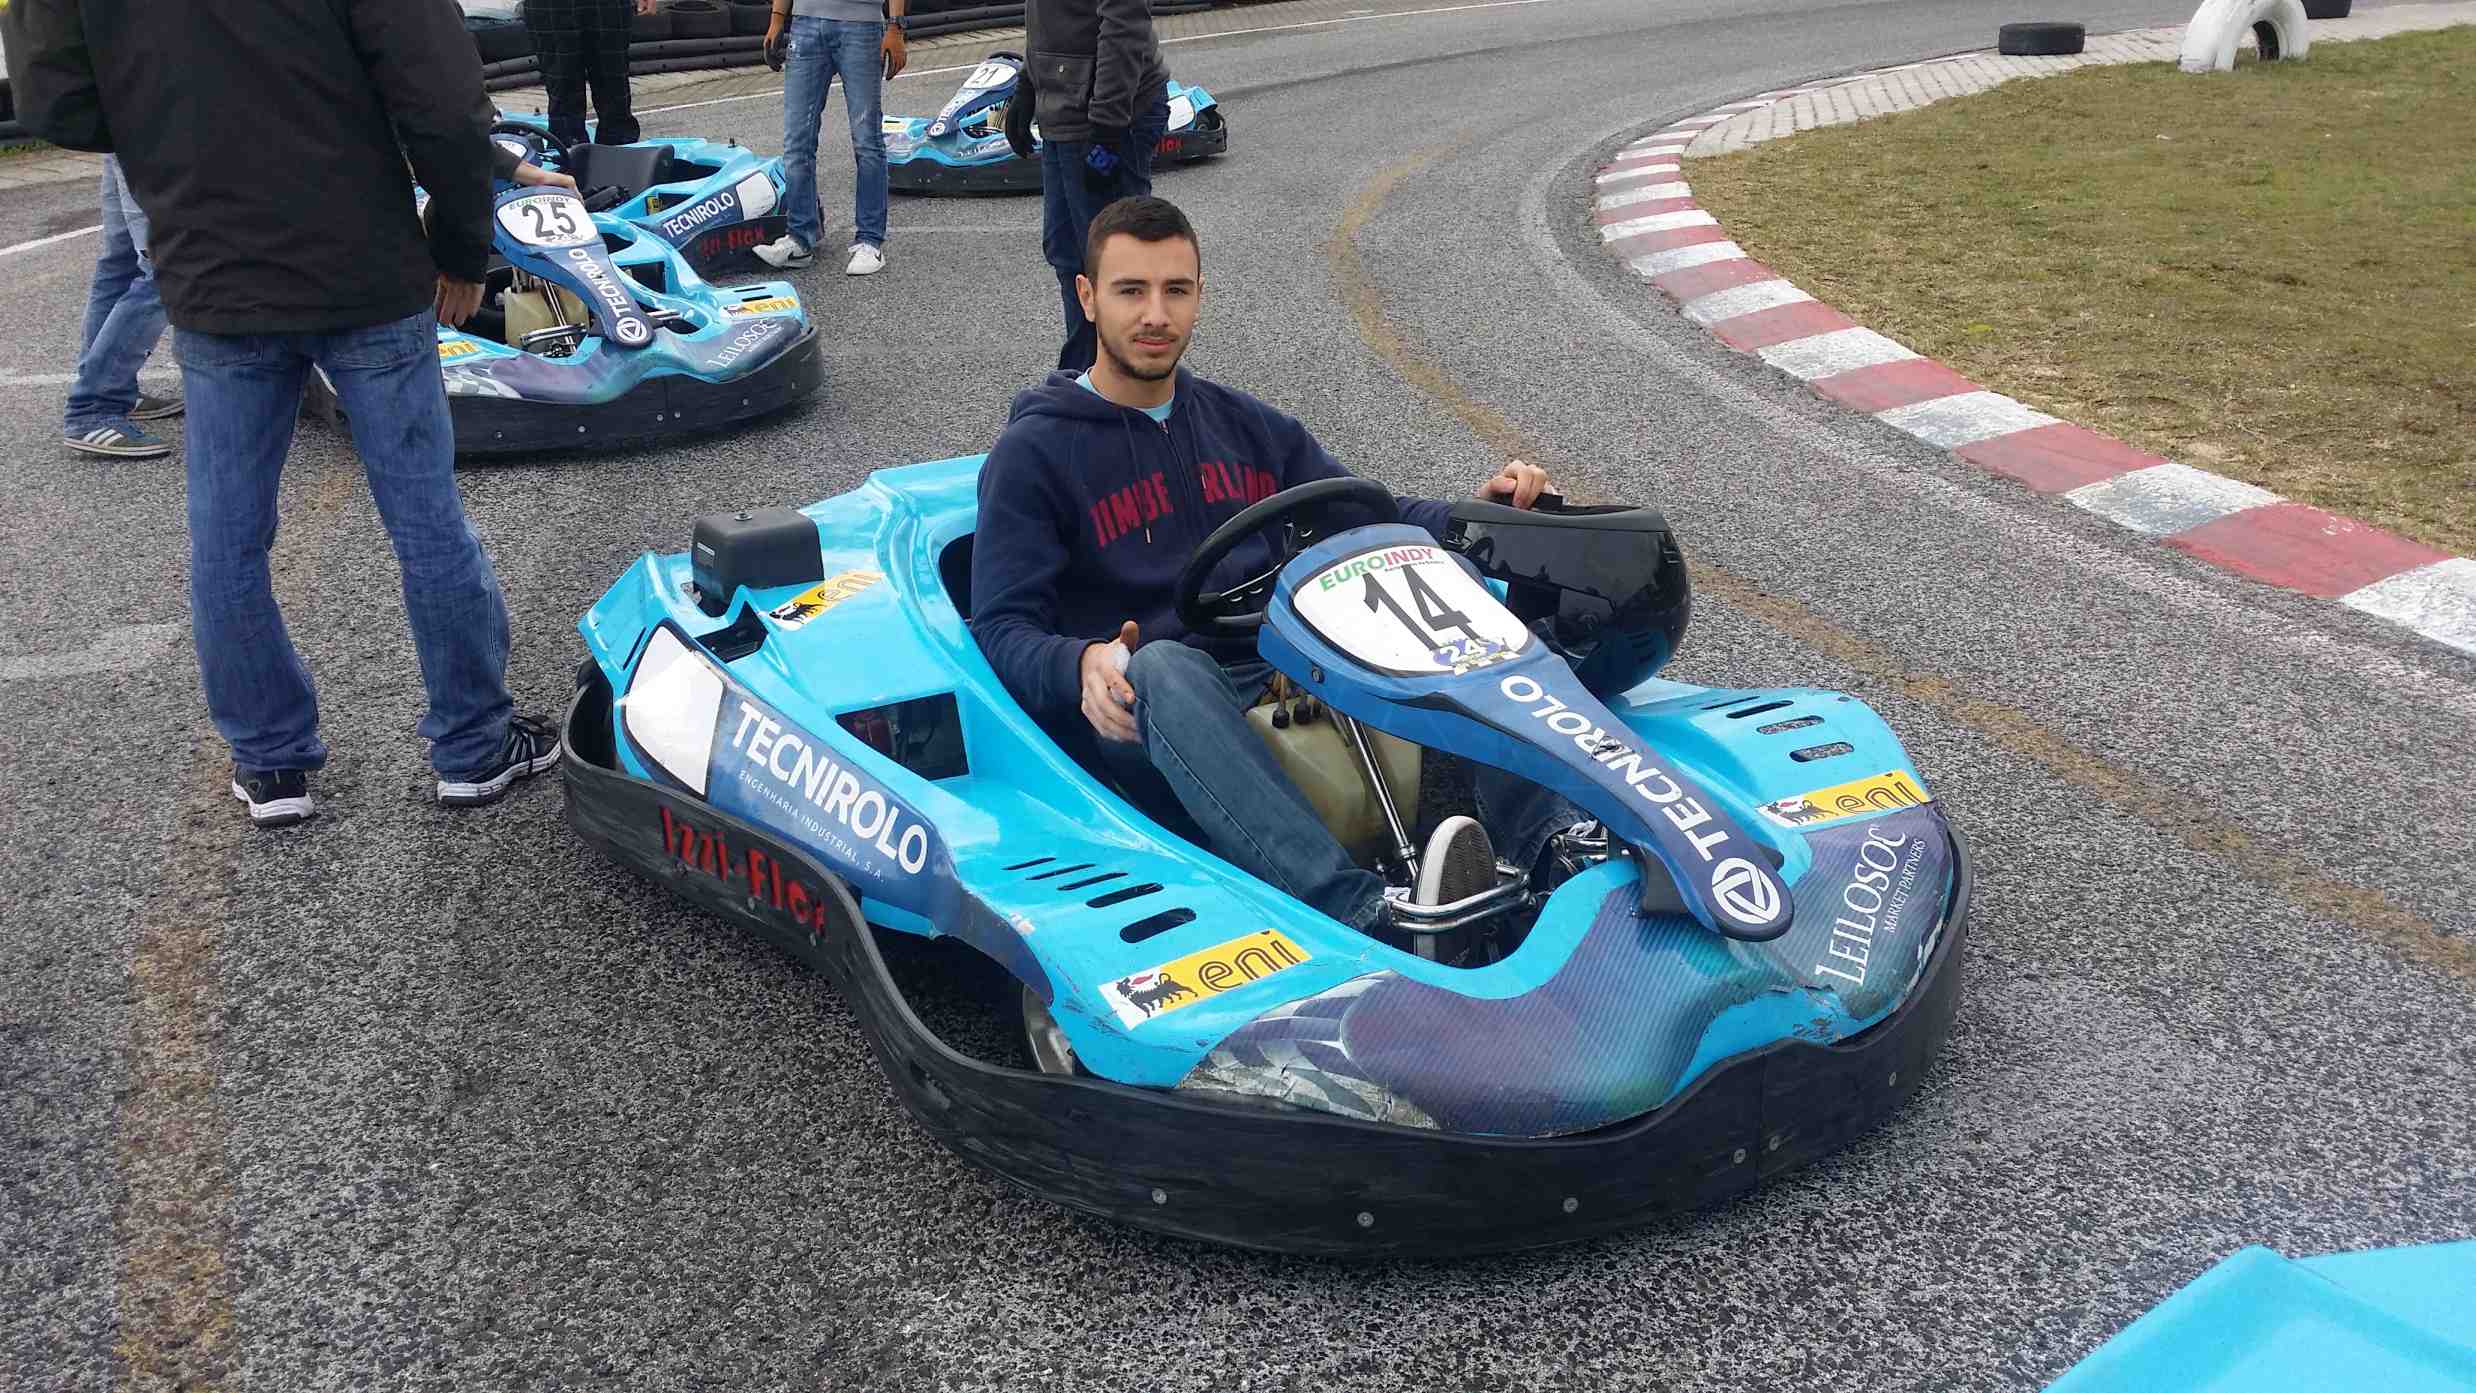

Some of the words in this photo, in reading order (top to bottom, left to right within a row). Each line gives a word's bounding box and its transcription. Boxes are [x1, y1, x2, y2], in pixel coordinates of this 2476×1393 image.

[522, 201, 576, 238] 25
[663, 192, 735, 238] TECNIROLO
[568, 248, 632, 318] TECNIROLO
[706, 320, 778, 368] LEILOSOC
[1319, 548, 1434, 592] EUROINDY
[1362, 564, 1482, 651] 14
[731, 700, 929, 875] TECNIROLO
[1500, 674, 1729, 862] TECNIROLO
[1835, 772, 1921, 815] eni
[738, 769, 800, 818] ENGENHARIA
[800, 814, 860, 866] INDUSTRIAL,
[1814, 823, 1906, 986] LEILOSOC
[1883, 887, 1909, 934] MARKET
[1898, 838, 1926, 889] PARTNERS
[1198, 929, 1297, 993] eni
